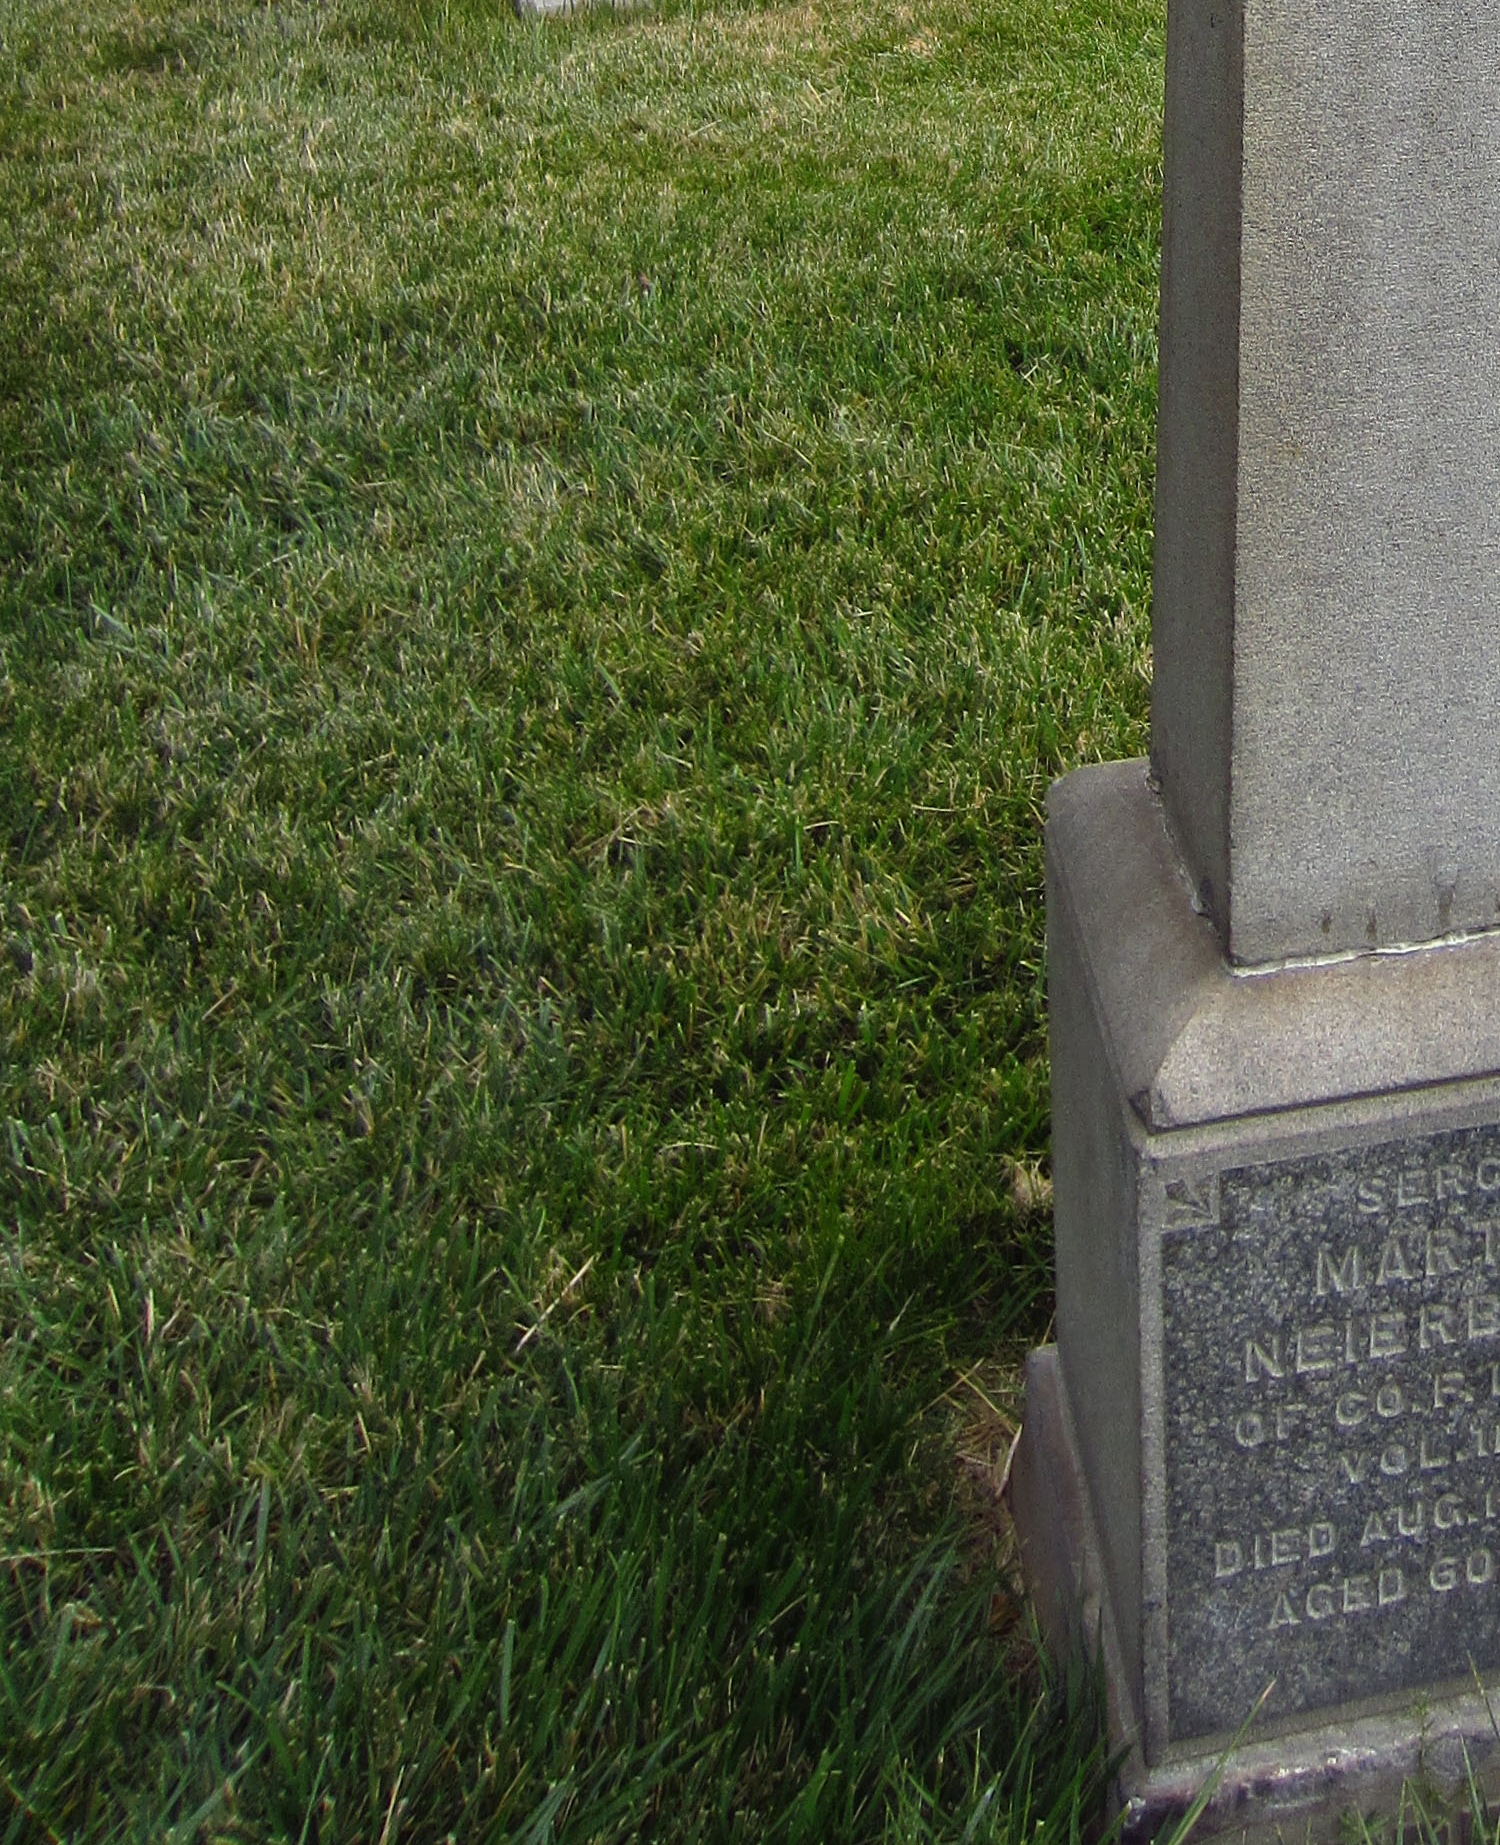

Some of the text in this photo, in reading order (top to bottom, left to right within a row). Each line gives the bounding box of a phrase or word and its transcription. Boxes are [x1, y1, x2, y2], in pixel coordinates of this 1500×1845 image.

[1235, 1403, 1308, 1449] OF
[1215, 1520, 1337, 1579] DIED
[1266, 1567, 1407, 1630] AGED
